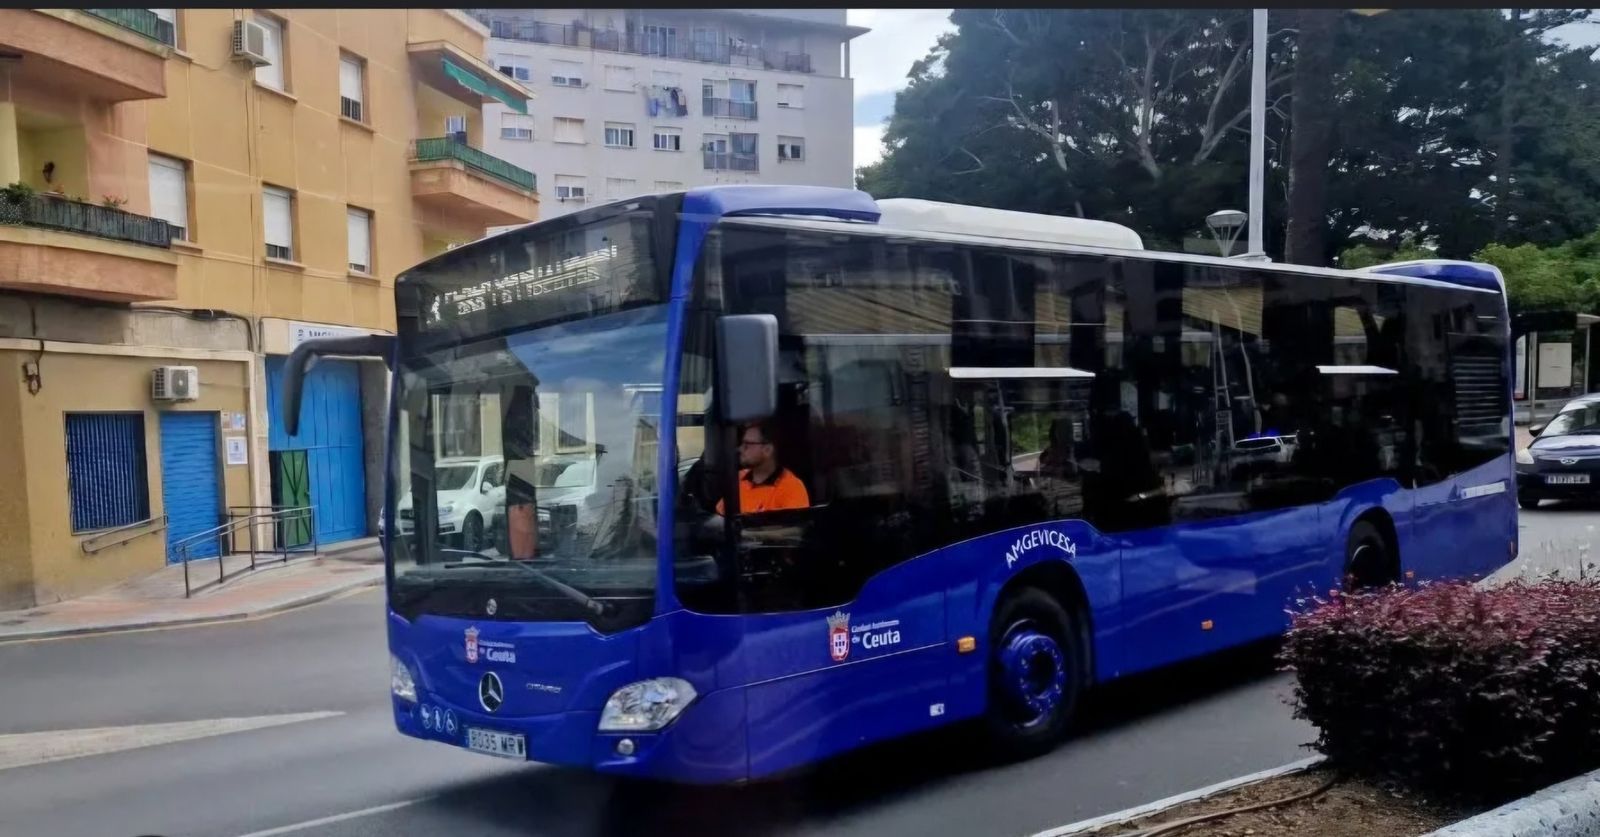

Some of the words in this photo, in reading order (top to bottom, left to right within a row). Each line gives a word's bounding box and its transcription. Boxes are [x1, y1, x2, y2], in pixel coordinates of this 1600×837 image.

[1005, 529, 1077, 569] AMGEVICESA
[862, 629, 901, 649] Ceuta
[486, 648, 516, 663] Ceuta
